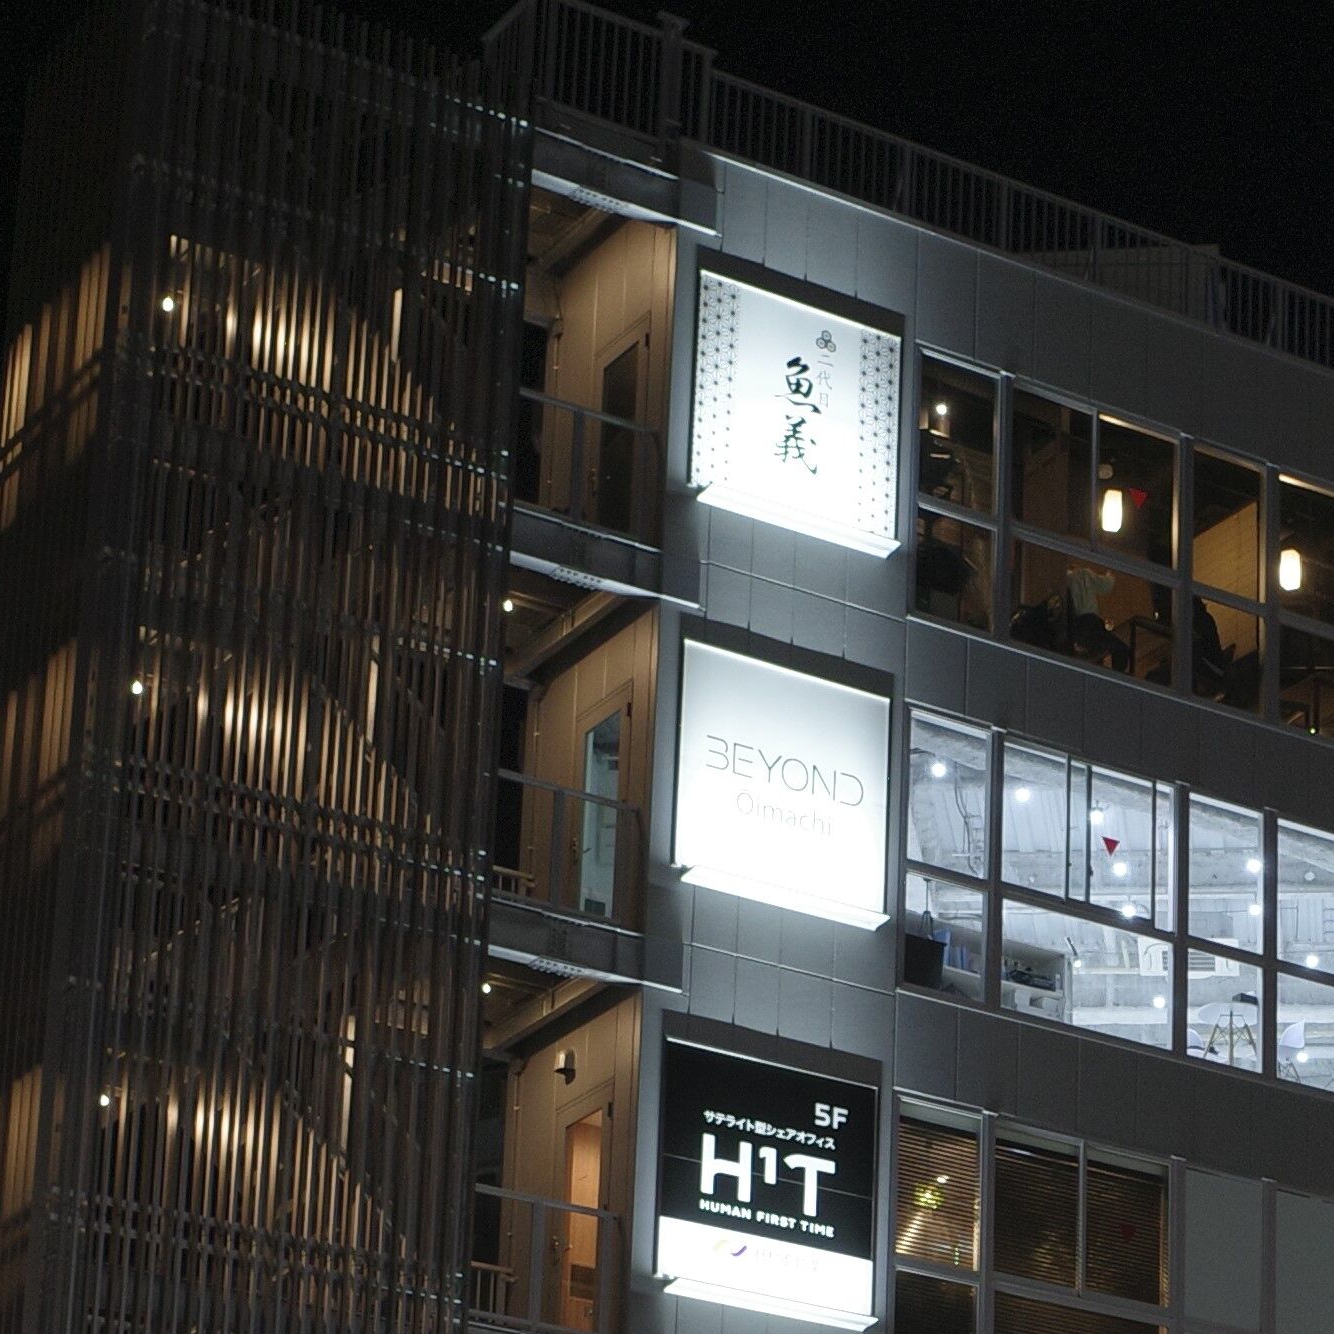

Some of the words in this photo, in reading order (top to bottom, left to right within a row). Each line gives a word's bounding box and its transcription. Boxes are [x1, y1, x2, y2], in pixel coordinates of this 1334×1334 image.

[707, 735, 864, 807] BEYOND
[814, 1102, 848, 1130] 5F
[699, 1198, 752, 1220] HUMAN
[756, 1208, 797, 1229] FIRST
[800, 1219, 835, 1238] TIME
